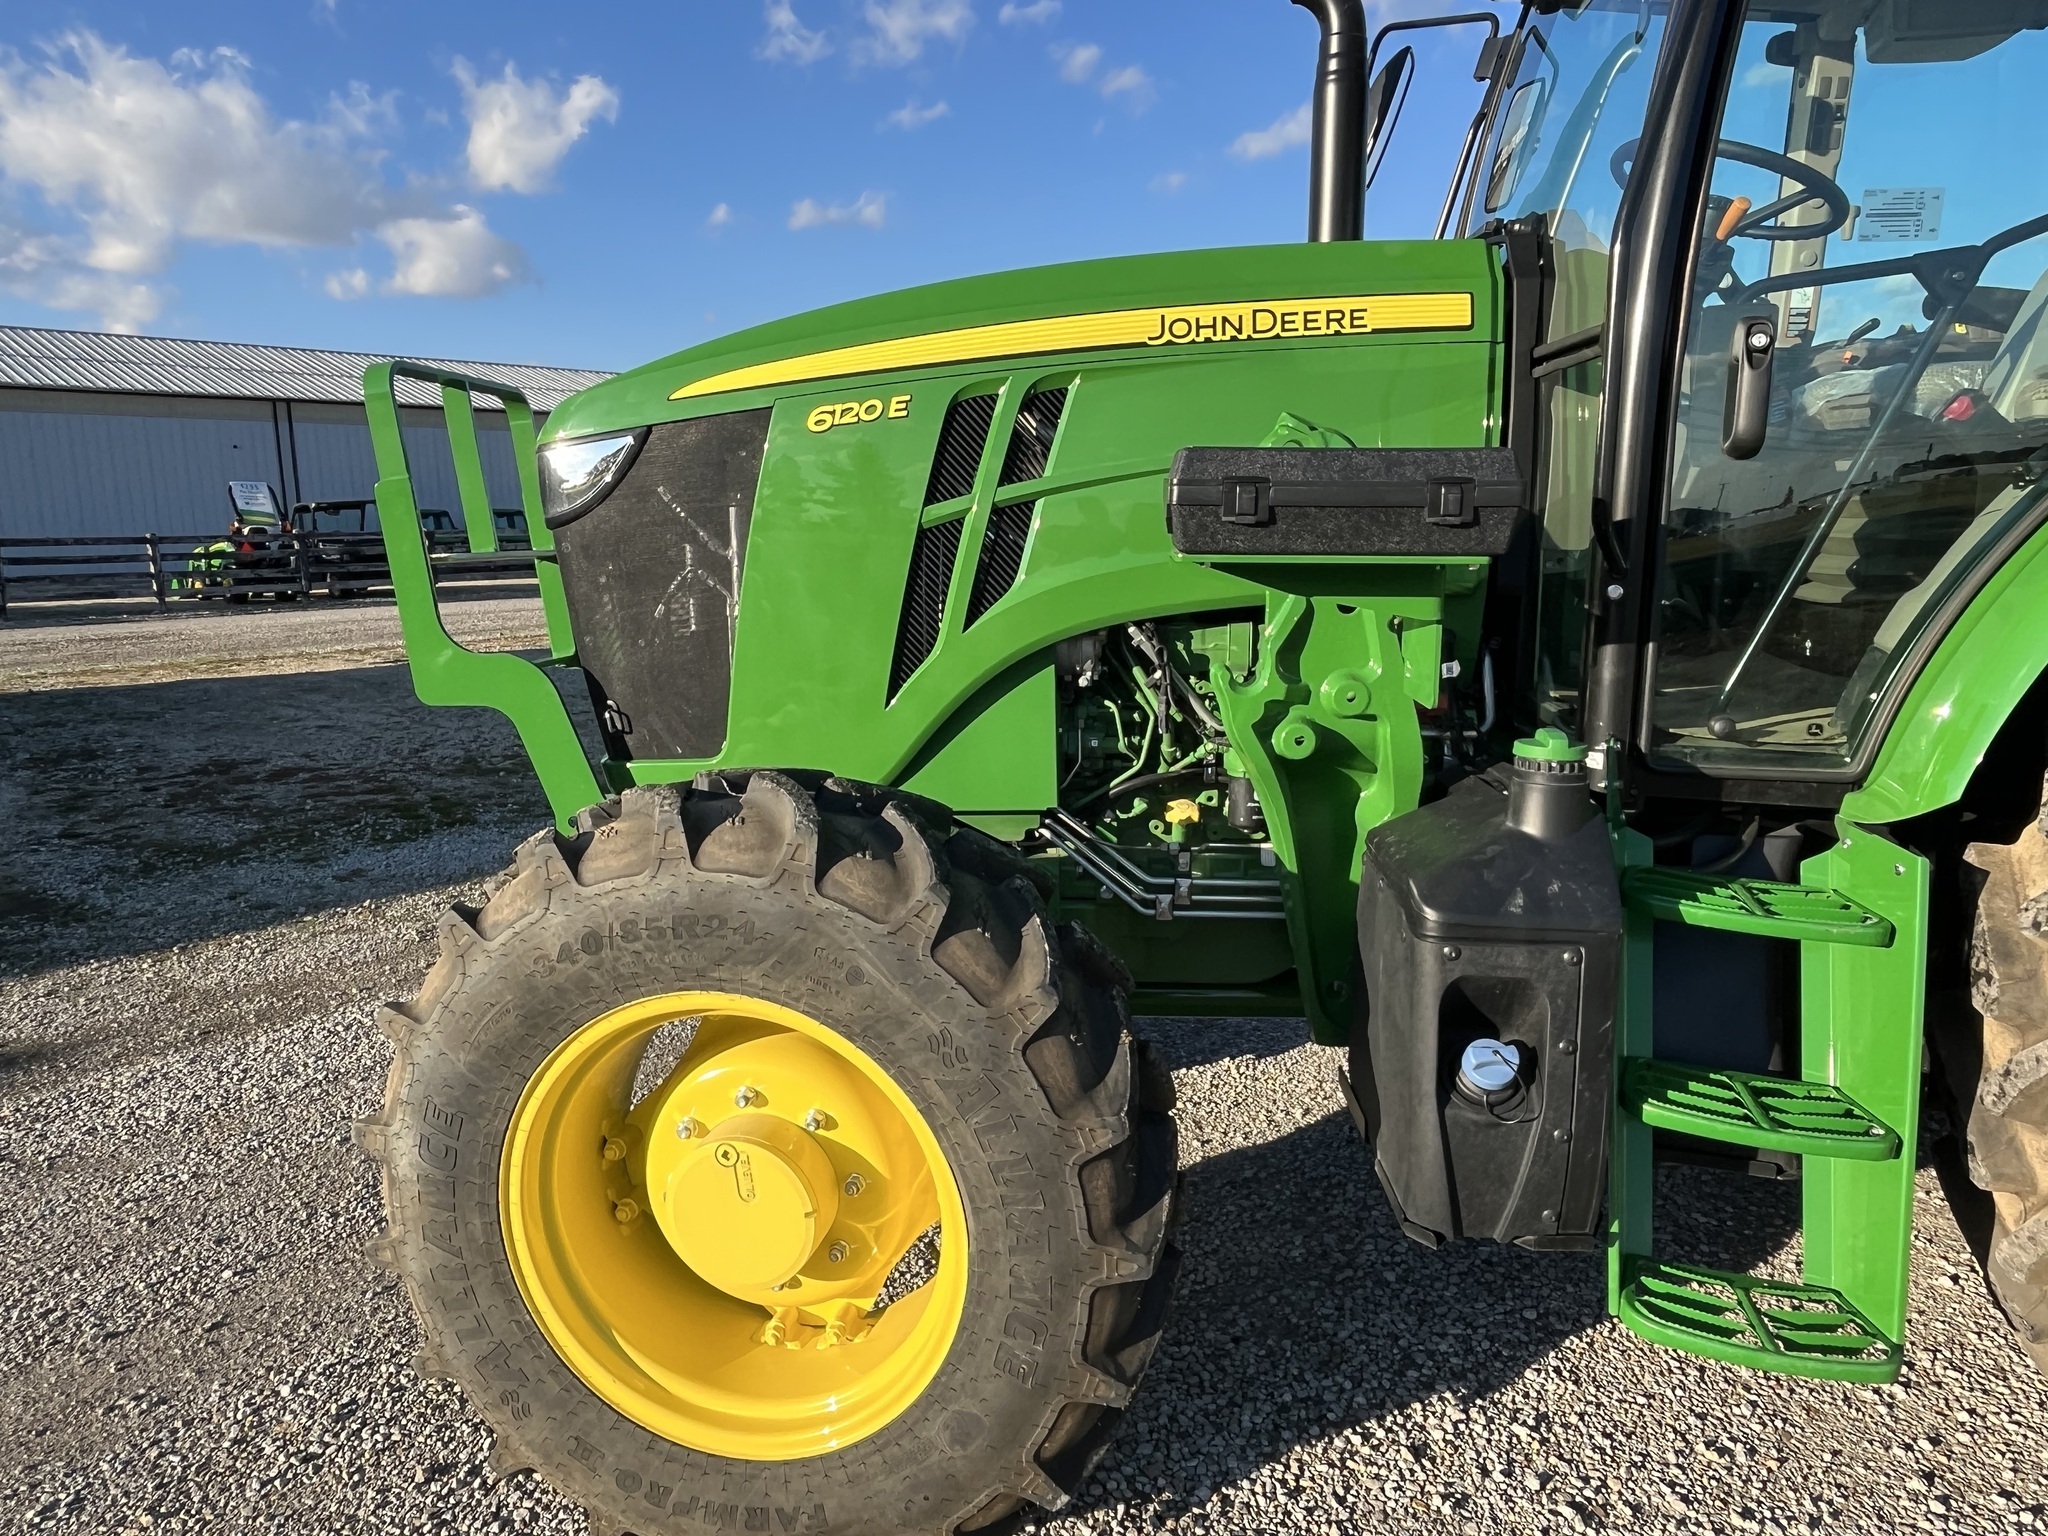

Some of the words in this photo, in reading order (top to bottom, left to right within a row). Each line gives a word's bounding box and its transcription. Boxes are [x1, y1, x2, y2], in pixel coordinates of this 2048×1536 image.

[1147, 313, 1243, 342] JOHN
[1251, 308, 1368, 335] DEERE
[806, 398, 884, 434] 6120
[887, 394, 912, 419] E
[532, 913, 756, 979] 340/85R24
[417, 1099, 529, 1383] ALLIANCE
[934, 1070, 1053, 1390] ALLIANCE
